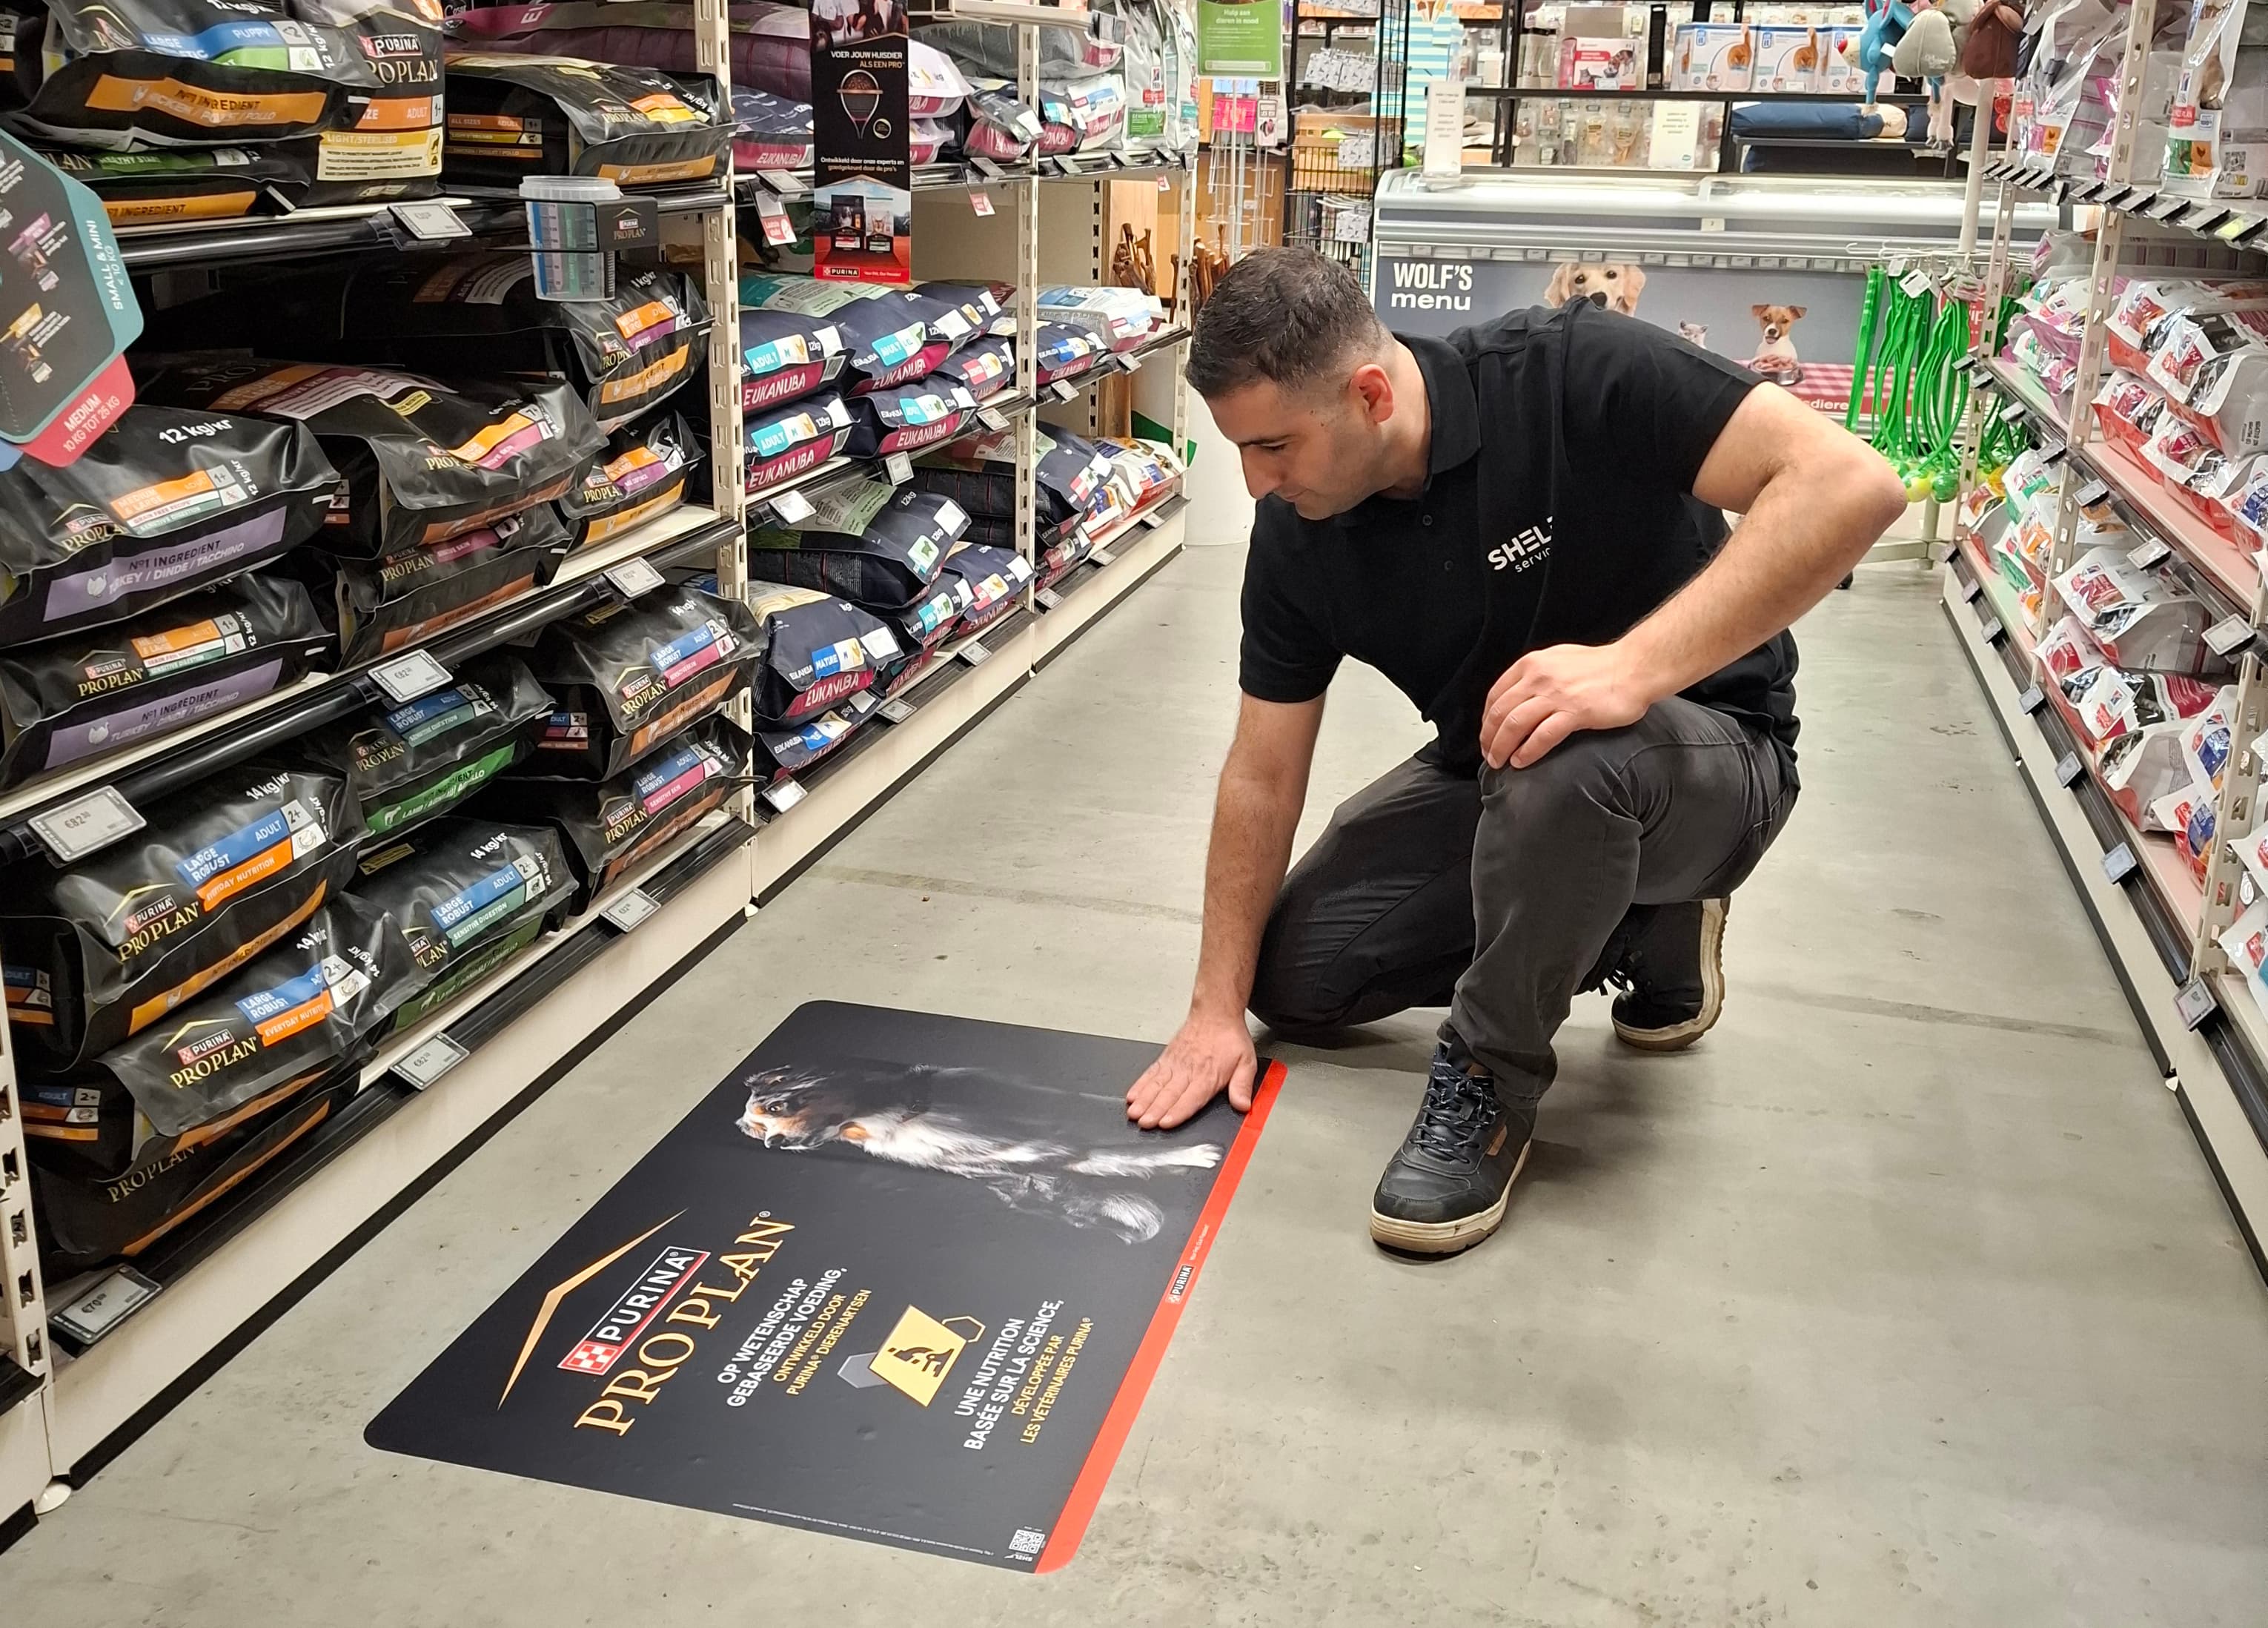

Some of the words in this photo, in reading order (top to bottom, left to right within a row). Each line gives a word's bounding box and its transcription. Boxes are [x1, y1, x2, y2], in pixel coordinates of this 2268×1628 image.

[1216, 16, 1235, 24] dieren
[1236, 16, 1242, 24] in
[1242, 16, 1259, 24] nood
[1224, 8, 1239, 17] Hulp
[232, 27, 271, 39] PUPPY
[374, 36, 420, 53] PURINA
[830, 50, 849, 59] VOER
[850, 51, 871, 59] JOUW
[871, 51, 903, 59] HUISDIER
[196, 95, 262, 110] INGREDIENT
[407, 106, 428, 119] ADULT
[756, 152, 802, 165] EUKANUBA
[876, 158, 898, 166] experts
[85, 219, 105, 251] MINI
[831, 268, 858, 276] PURINA
[1393, 262, 1473, 291] WOLF'S
[100, 261, 124, 311] SMALL
[1390, 291, 1471, 311] menu
[808, 340, 822, 353] 12kg
[752, 351, 778, 371] ADULT
[743, 372, 806, 407] EUKANUBA
[62, 437, 77, 453] 10
[71, 428, 87, 446] KG
[82, 414, 101, 436] TOT
[105, 395, 122, 412] KG
[63, 393, 102, 432] MEDIUM
[815, 415, 832, 428] 12kg
[159, 428, 184, 444] 12
[184, 417, 233, 438] kg/kr
[760, 434, 786, 451] ADULT
[896, 423, 947, 447] EUKANUBA
[749, 449, 815, 489] EUKANUBA
[246, 483, 259, 497] 12
[584, 489, 603, 503] PRO
[901, 491, 918, 506] 12kg
[153, 539, 222, 569] INGREDIENT
[153, 562, 188, 580] DINDE
[196, 542, 245, 568] TACCHINO
[380, 566, 405, 582] PRO
[405, 555, 436, 574] PLAN
[246, 634, 259, 647] 12
[653, 645, 674, 662] LARGE
[660, 649, 683, 669] ROBUST
[815, 654, 838, 673] MATURE
[94, 660, 125, 675] PURINA
[79, 677, 109, 697] PRO
[109, 667, 142, 689] PLAN
[805, 670, 860, 707] EUKANUBA
[159, 689, 219, 718] INGREDIENT
[621, 695, 645, 715] PRO
[642, 681, 664, 704] PLAN
[390, 707, 417, 724] LARGE
[397, 709, 425, 729] ROBUST
[573, 715, 586, 724] 2+
[246, 786, 263, 800] 14
[262, 771, 291, 795] kg/kr
[641, 775, 666, 795] ROBUST
[288, 808, 302, 824] 2+
[610, 801, 634, 822] PURINA
[606, 824, 631, 844] PRO
[628, 807, 647, 834] PLAN
[184, 847, 218, 873] LARGE
[254, 820, 282, 843] ADULT
[470, 846, 484, 860] 14
[483, 831, 508, 853] kg/kr
[192, 853, 231, 882] ROBUST
[236, 856, 275, 884] NUTRITION
[517, 861, 531, 875] 2+
[435, 896, 465, 918] LARGE
[493, 870, 517, 890] ADULT
[443, 899, 475, 926] ROBUST
[479, 901, 508, 925] DIGESTION
[118, 931, 150, 962] PRO
[324, 961, 342, 978] 2+
[242, 992, 275, 1010] LARGE
[250, 998, 289, 1019] ROBUST
[265, 1014, 299, 1037] EVERYDAY
[170, 1060, 210, 1089] PRO
[79, 1091, 98, 1102] 2+
[107, 1173, 147, 1203] PRO
[146, 1145, 196, 1182] PLAN
[1172, 1265, 1193, 1296] PURINA
[717, 1363, 742, 1384] OP
[731, 1277, 809, 1363] WETENSCHAP
[815, 1288, 872, 1356] DIERENARTSEN
[1016, 1299, 1066, 1355] SCIENCE,
[726, 1323, 803, 1408] GEBASEERDE
[789, 1267, 849, 1328] VOEDING,
[772, 1320, 826, 1383] ONTWIKKELD
[820, 1293, 847, 1323] DOOR
[954, 1386, 987, 1417] UNE
[971, 1317, 1027, 1387] NUTRITION
[1005, 1356, 1032, 1375] LA
[1010, 1354, 1055, 1415] DÉVELOPPÉE
[1044, 1334, 1066, 1355] PAR
[574, 1332, 695, 1437] PRO
[990, 1374, 1021, 1404] SUR
[1029, 1354, 1077, 1423] VÉTÉRINAIRES
[963, 1403, 1004, 1451] BASÉE
[1019, 1423, 1042, 1444] LES
